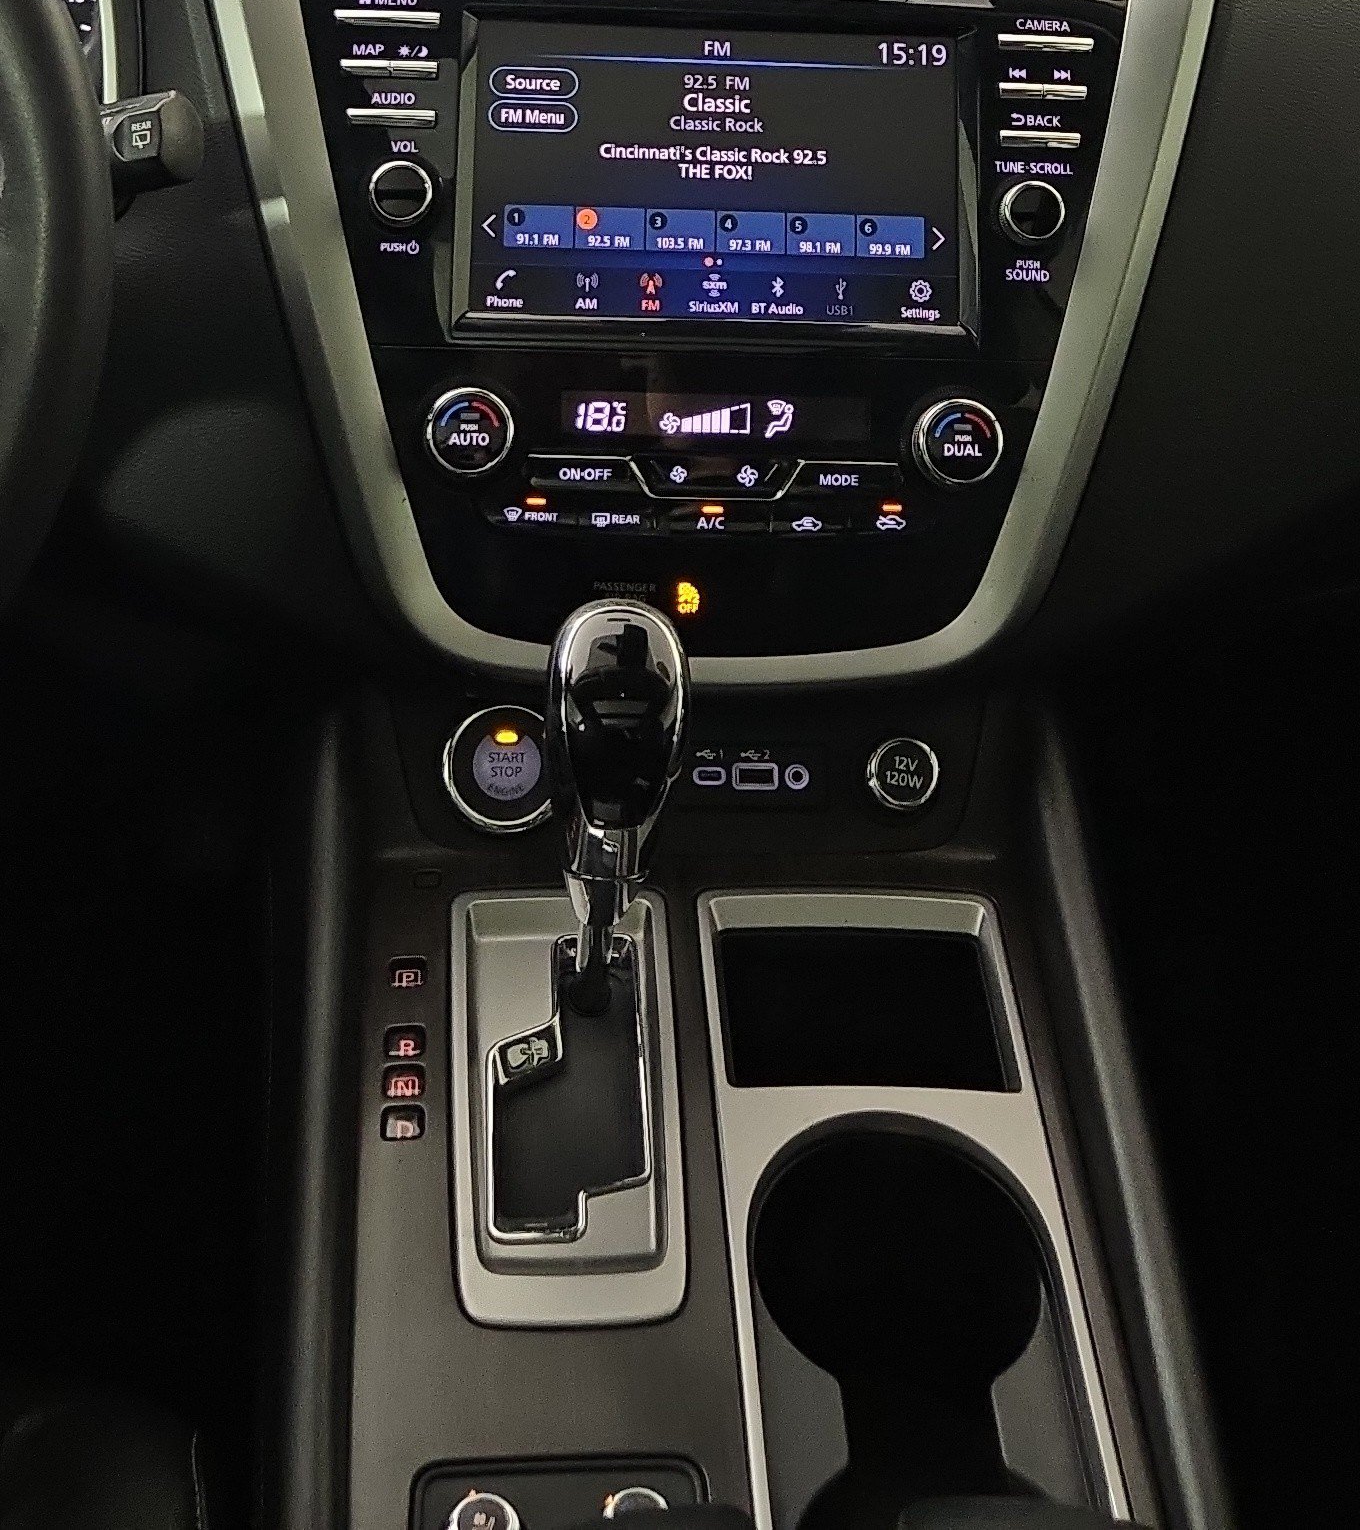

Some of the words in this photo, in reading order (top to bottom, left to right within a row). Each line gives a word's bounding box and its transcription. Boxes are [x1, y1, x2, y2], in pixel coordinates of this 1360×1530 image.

[1016, 19, 1070, 32] CAMERA
[352, 44, 384, 56] MAP
[704, 41, 731, 56] FM
[878, 42, 947, 66] 15:19
[505, 74, 561, 91] Source
[683, 75, 717, 89] 92.5
[725, 76, 750, 91] FM
[371, 92, 415, 105] AUDIO
[683, 93, 751, 113] Classic
[500, 109, 524, 123] FM
[525, 109, 565, 125] Menu
[1027, 115, 1061, 127] BACK
[131, 121, 152, 131] REAR
[670, 115, 721, 132] Classic
[725, 118, 763, 133] Rock
[391, 140, 419, 153] VOL
[599, 143, 692, 161] Cincinnati's
[695, 146, 747, 163] Classic
[751, 149, 790, 164] Rock
[793, 149, 827, 165] 92.5
[678, 163, 710, 179] THE
[714, 164, 752, 180] FOX!
[513, 212, 519, 223] 1
[583, 214, 591, 225] 2
[654, 217, 662, 228] 3
[723, 218, 733, 229] 4
[794, 221, 803, 231] 5
[864, 223, 872, 233] 6
[516, 233, 539, 246] 91.1
[543, 233, 559, 246] FM
[587, 234, 611, 248] 92.5
[614, 235, 630, 248] FM
[656, 237, 685, 250] 103.5
[688, 237, 704, 250] FM
[729, 239, 752, 251] 97.3
[755, 240, 771, 252] FM
[380, 242, 406, 252] PUSH
[799, 241, 821, 253] 98.1
[825, 242, 841, 254] FM
[868, 243, 892, 255] 99.9
[895, 244, 911, 256] FM
[1016, 259, 1040, 269] PUSH
[1006, 269, 1050, 282] SOUND
[486, 295, 524, 308] Phone
[575, 298, 598, 310] AM
[641, 299, 660, 311] FM
[688, 301, 739, 314] SiriusXM
[751, 303, 767, 314] BT
[768, 303, 804, 315] Audio
[826, 305, 854, 316] USB1
[900, 306, 940, 320] Settings
[460, 423, 479, 431] PUSH
[448, 433, 490, 446] AUTO
[954, 434, 972, 442] PUSH
[943, 443, 983, 457] DUAL
[819, 474, 859, 486] MODE
[524, 512, 558, 522] FRONT
[612, 514, 641, 525] REAR
[696, 517, 725, 529] A/C
[593, 580, 657, 593] PASSENGER
[678, 603, 699, 614] OFF
[487, 752, 525, 763] START
[763, 749, 770, 760] 2
[894, 756, 919, 770] 12V
[491, 766, 522, 778] STOP
[885, 771, 924, 789] 120W
[487, 783, 525, 796] ENGINE
[402, 972, 415, 987] P
[399, 1038, 415, 1057] R
[398, 1080, 413, 1096] N
[397, 1120, 414, 1139] D
